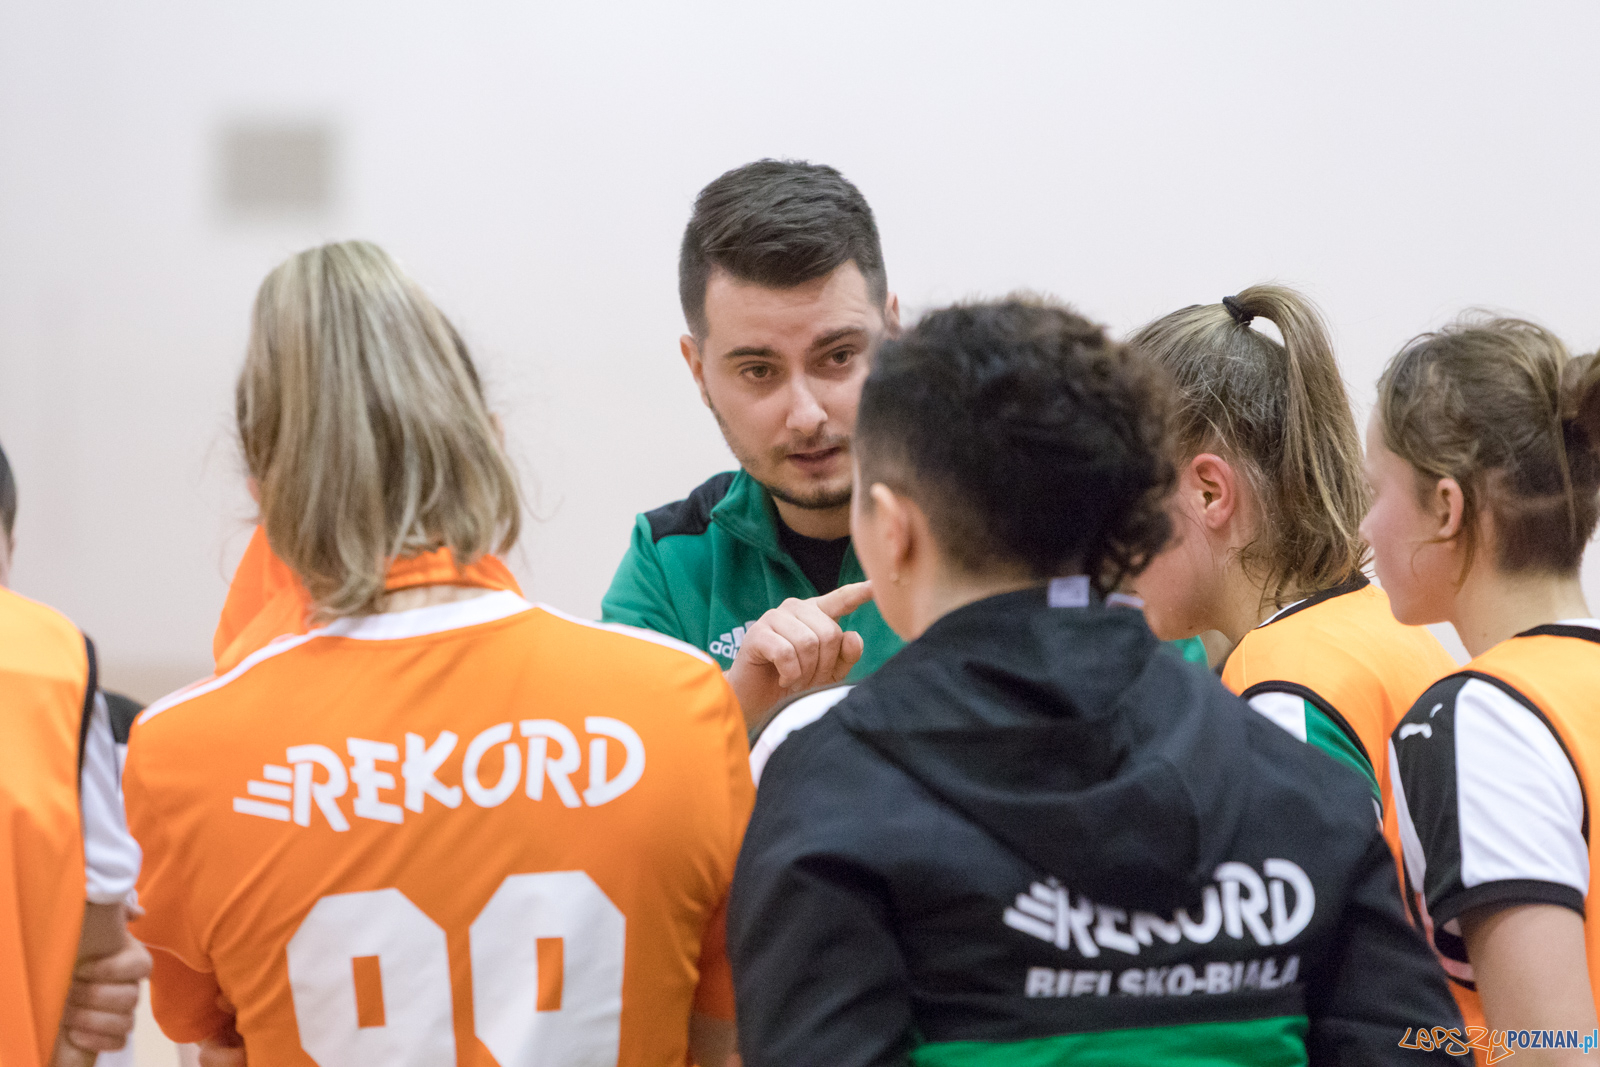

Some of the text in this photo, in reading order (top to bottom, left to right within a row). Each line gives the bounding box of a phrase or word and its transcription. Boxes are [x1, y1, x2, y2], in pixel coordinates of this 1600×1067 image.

[709, 641, 740, 660] adi
[286, 716, 646, 832] REKORD
[286, 870, 627, 1067] 99
